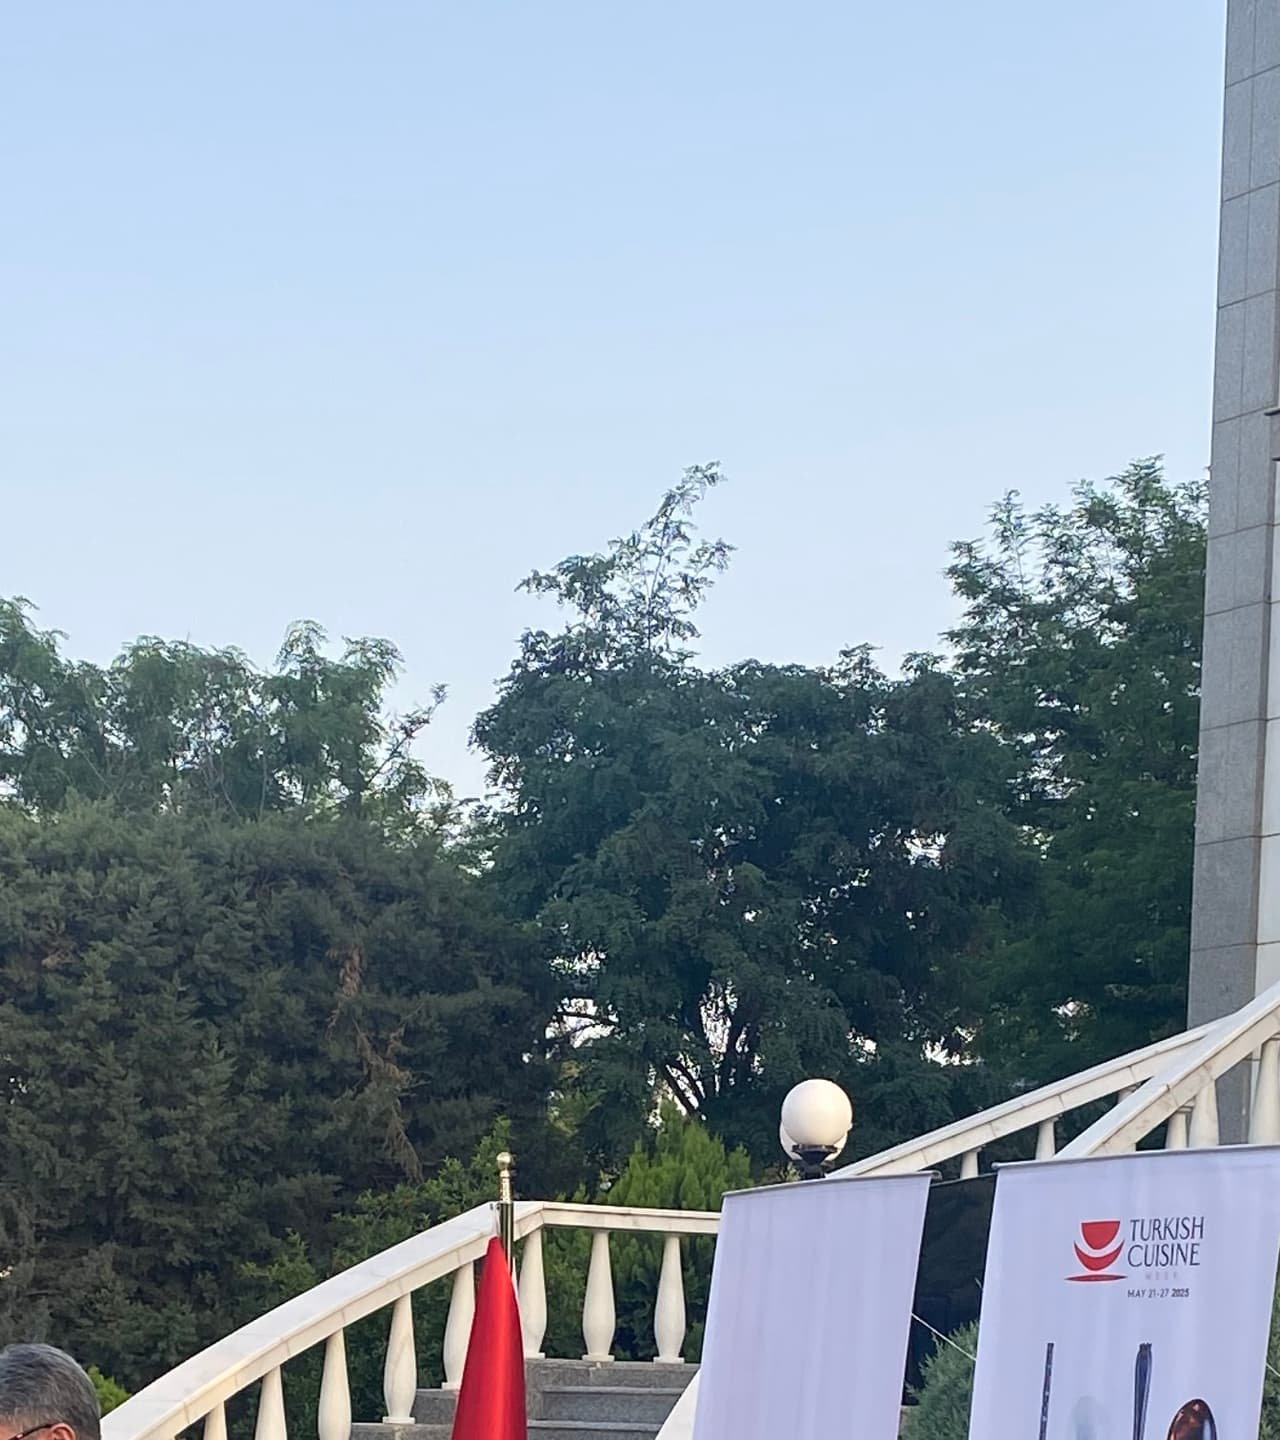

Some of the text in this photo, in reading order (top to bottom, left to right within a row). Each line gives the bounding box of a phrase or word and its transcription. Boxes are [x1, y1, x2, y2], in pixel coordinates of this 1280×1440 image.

[1130, 1216, 1205, 1241] TURKISH
[1127, 1243, 1200, 1267] CUISINE
[1127, 1288, 1190, 1298] MAY 21-27 2025
